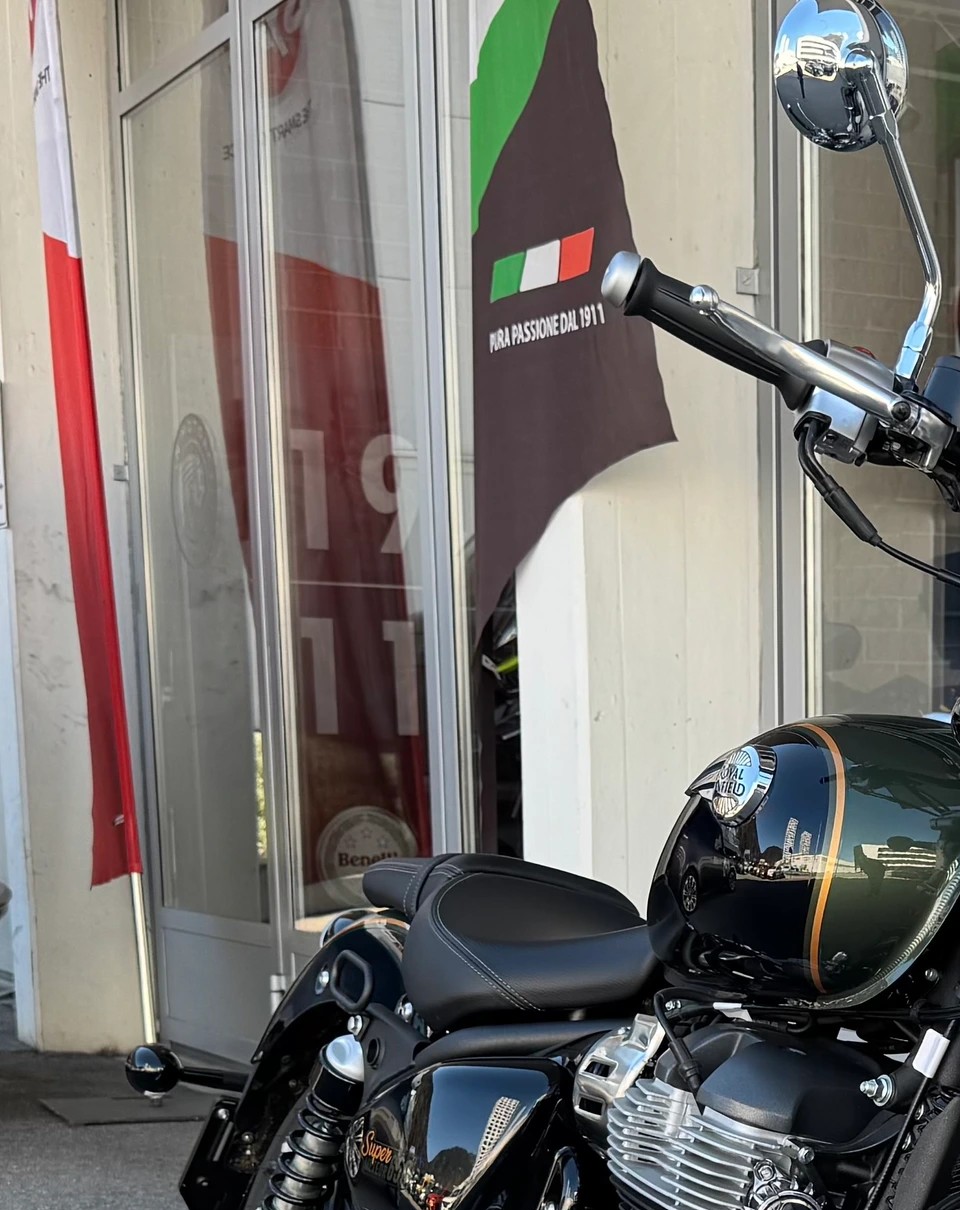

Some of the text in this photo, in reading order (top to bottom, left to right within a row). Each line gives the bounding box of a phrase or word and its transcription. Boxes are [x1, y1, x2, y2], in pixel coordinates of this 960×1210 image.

[511, 313, 560, 345] PASSIONE
[560, 308, 579, 334] DAL
[579, 302, 605, 328] 1911
[361, 1130, 393, 1165] Super
